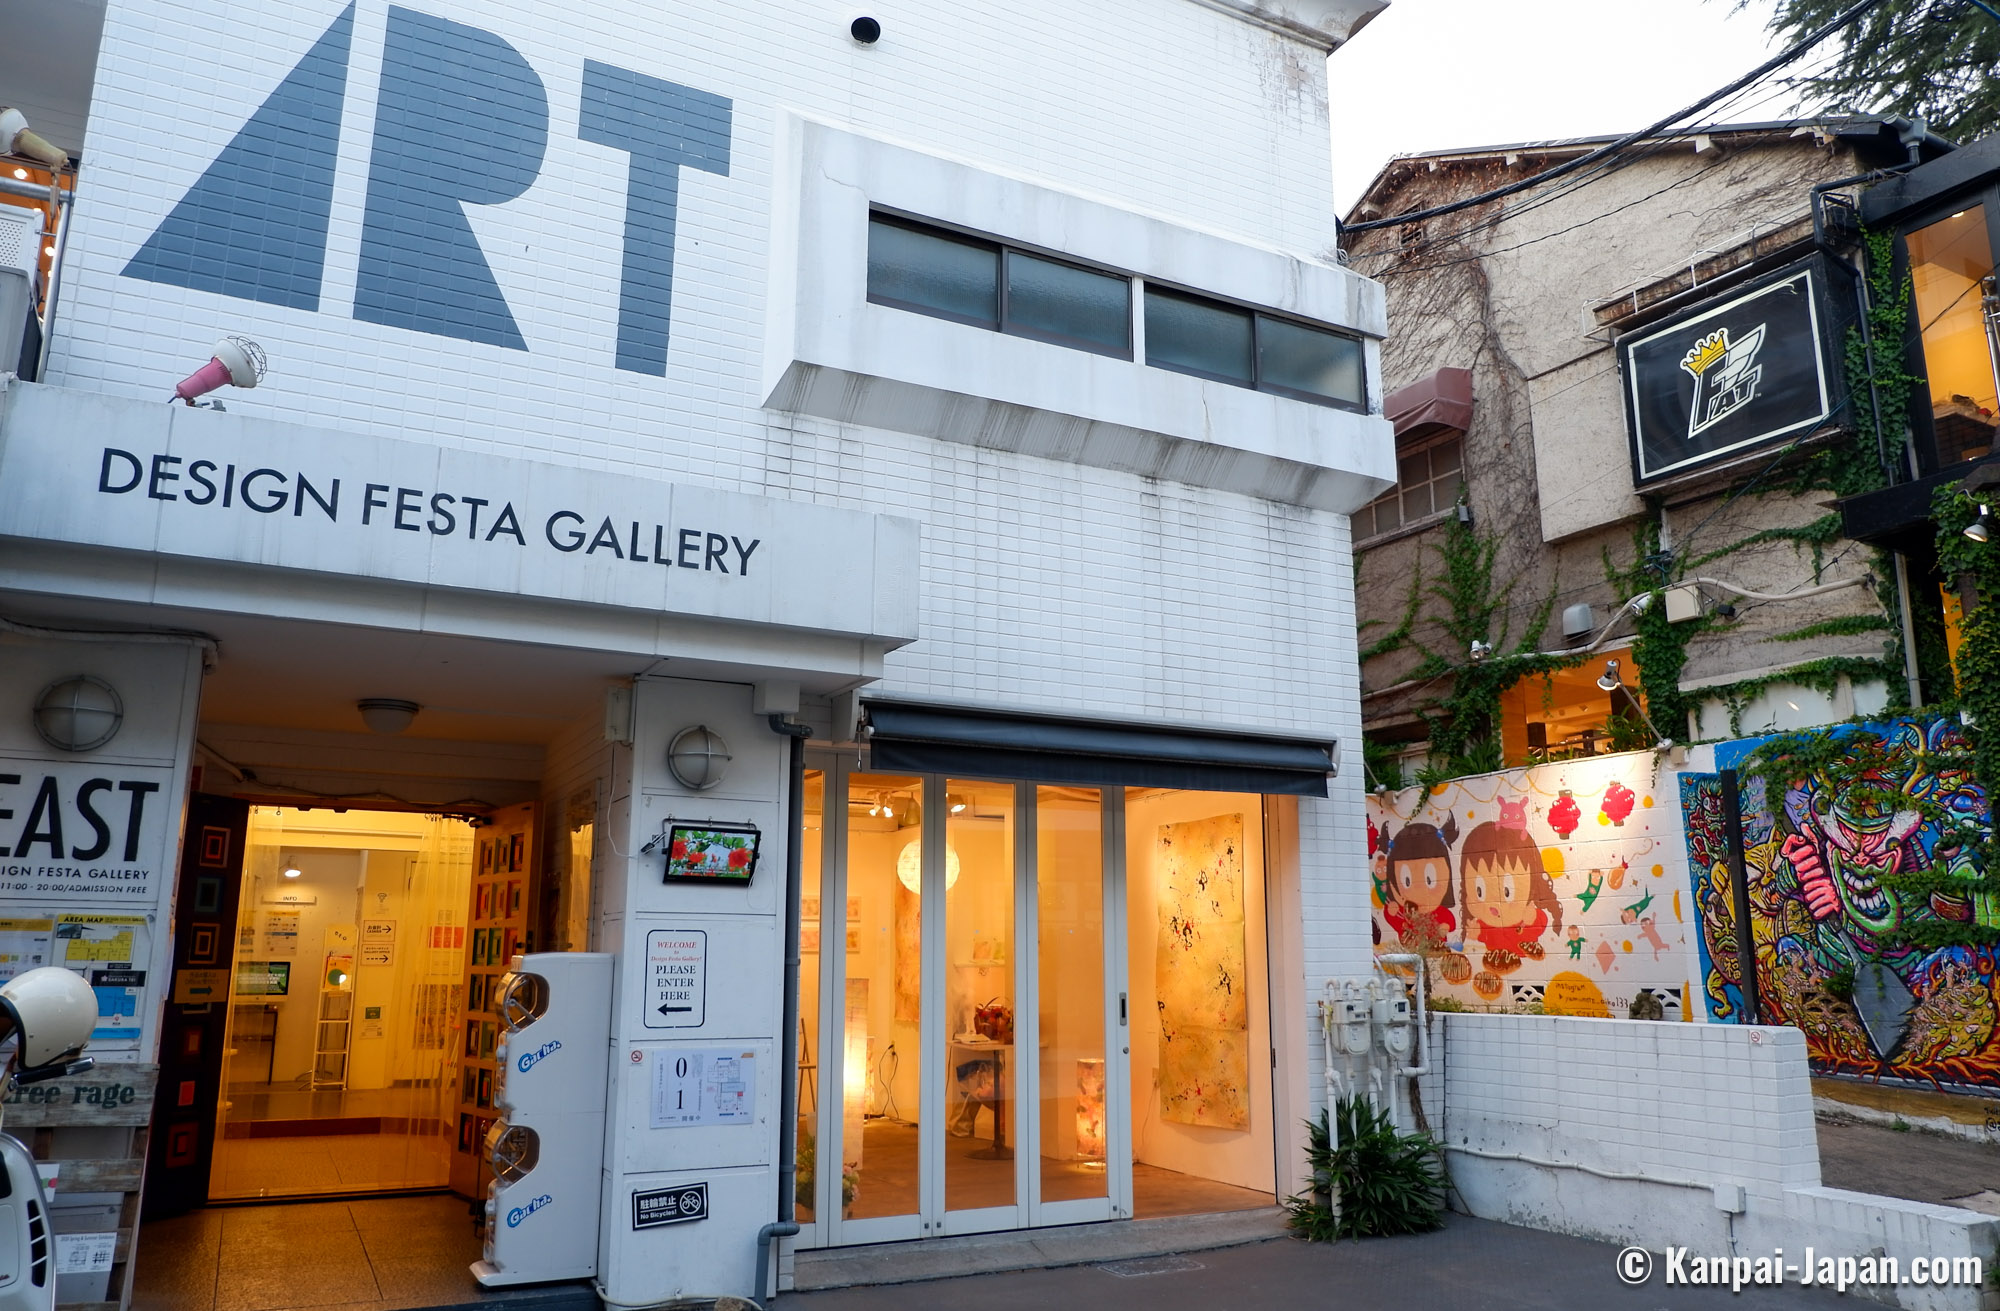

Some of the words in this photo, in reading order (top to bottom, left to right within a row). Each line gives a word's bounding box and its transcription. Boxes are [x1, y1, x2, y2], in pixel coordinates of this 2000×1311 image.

[119, 0, 733, 377] ART
[98, 447, 341, 523] DESIGN
[362, 484, 527, 546] FESTA
[545, 510, 761, 576] GALLERY
[0, 774, 159, 862] EAST
[38, 867, 82, 878] FESTA
[88, 868, 149, 880] GALLERY
[1, 882, 27, 891] 11:00
[36, 884, 123, 893] 20:00/ADMISSION
[126, 886, 147, 894] FREE
[655, 965, 696, 974] PLEASE
[1724, 956, 1741, 980] 福
[657, 978, 694, 987] ENTER
[660, 991, 690, 1000] HERE
[675, 1057, 687, 1078] 0
[71, 1083, 135, 1109] rage
[676, 1089, 684, 1109] 1
[640, 1196, 676, 1209] 駐輪禁止
[650, 1209, 677, 1218] Bicycles!
